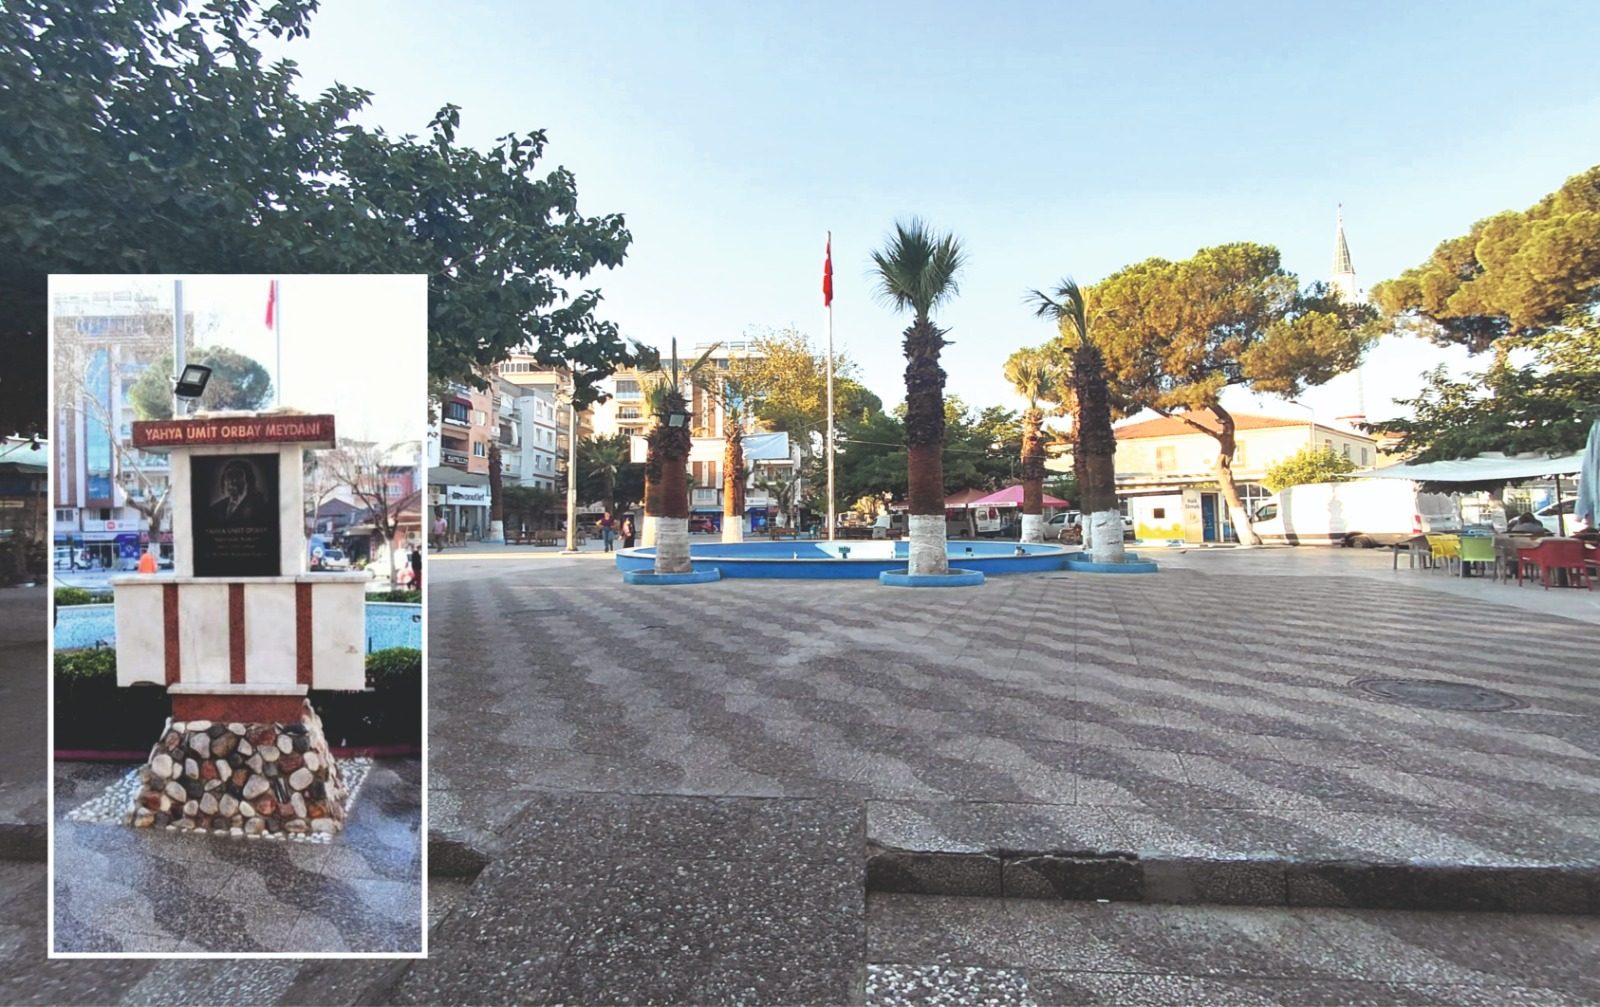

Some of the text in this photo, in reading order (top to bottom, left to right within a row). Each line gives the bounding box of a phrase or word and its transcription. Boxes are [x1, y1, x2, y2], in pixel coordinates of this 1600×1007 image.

[145, 422, 321, 441] YAHYA ÜMİT ORBAY MEYDANI
